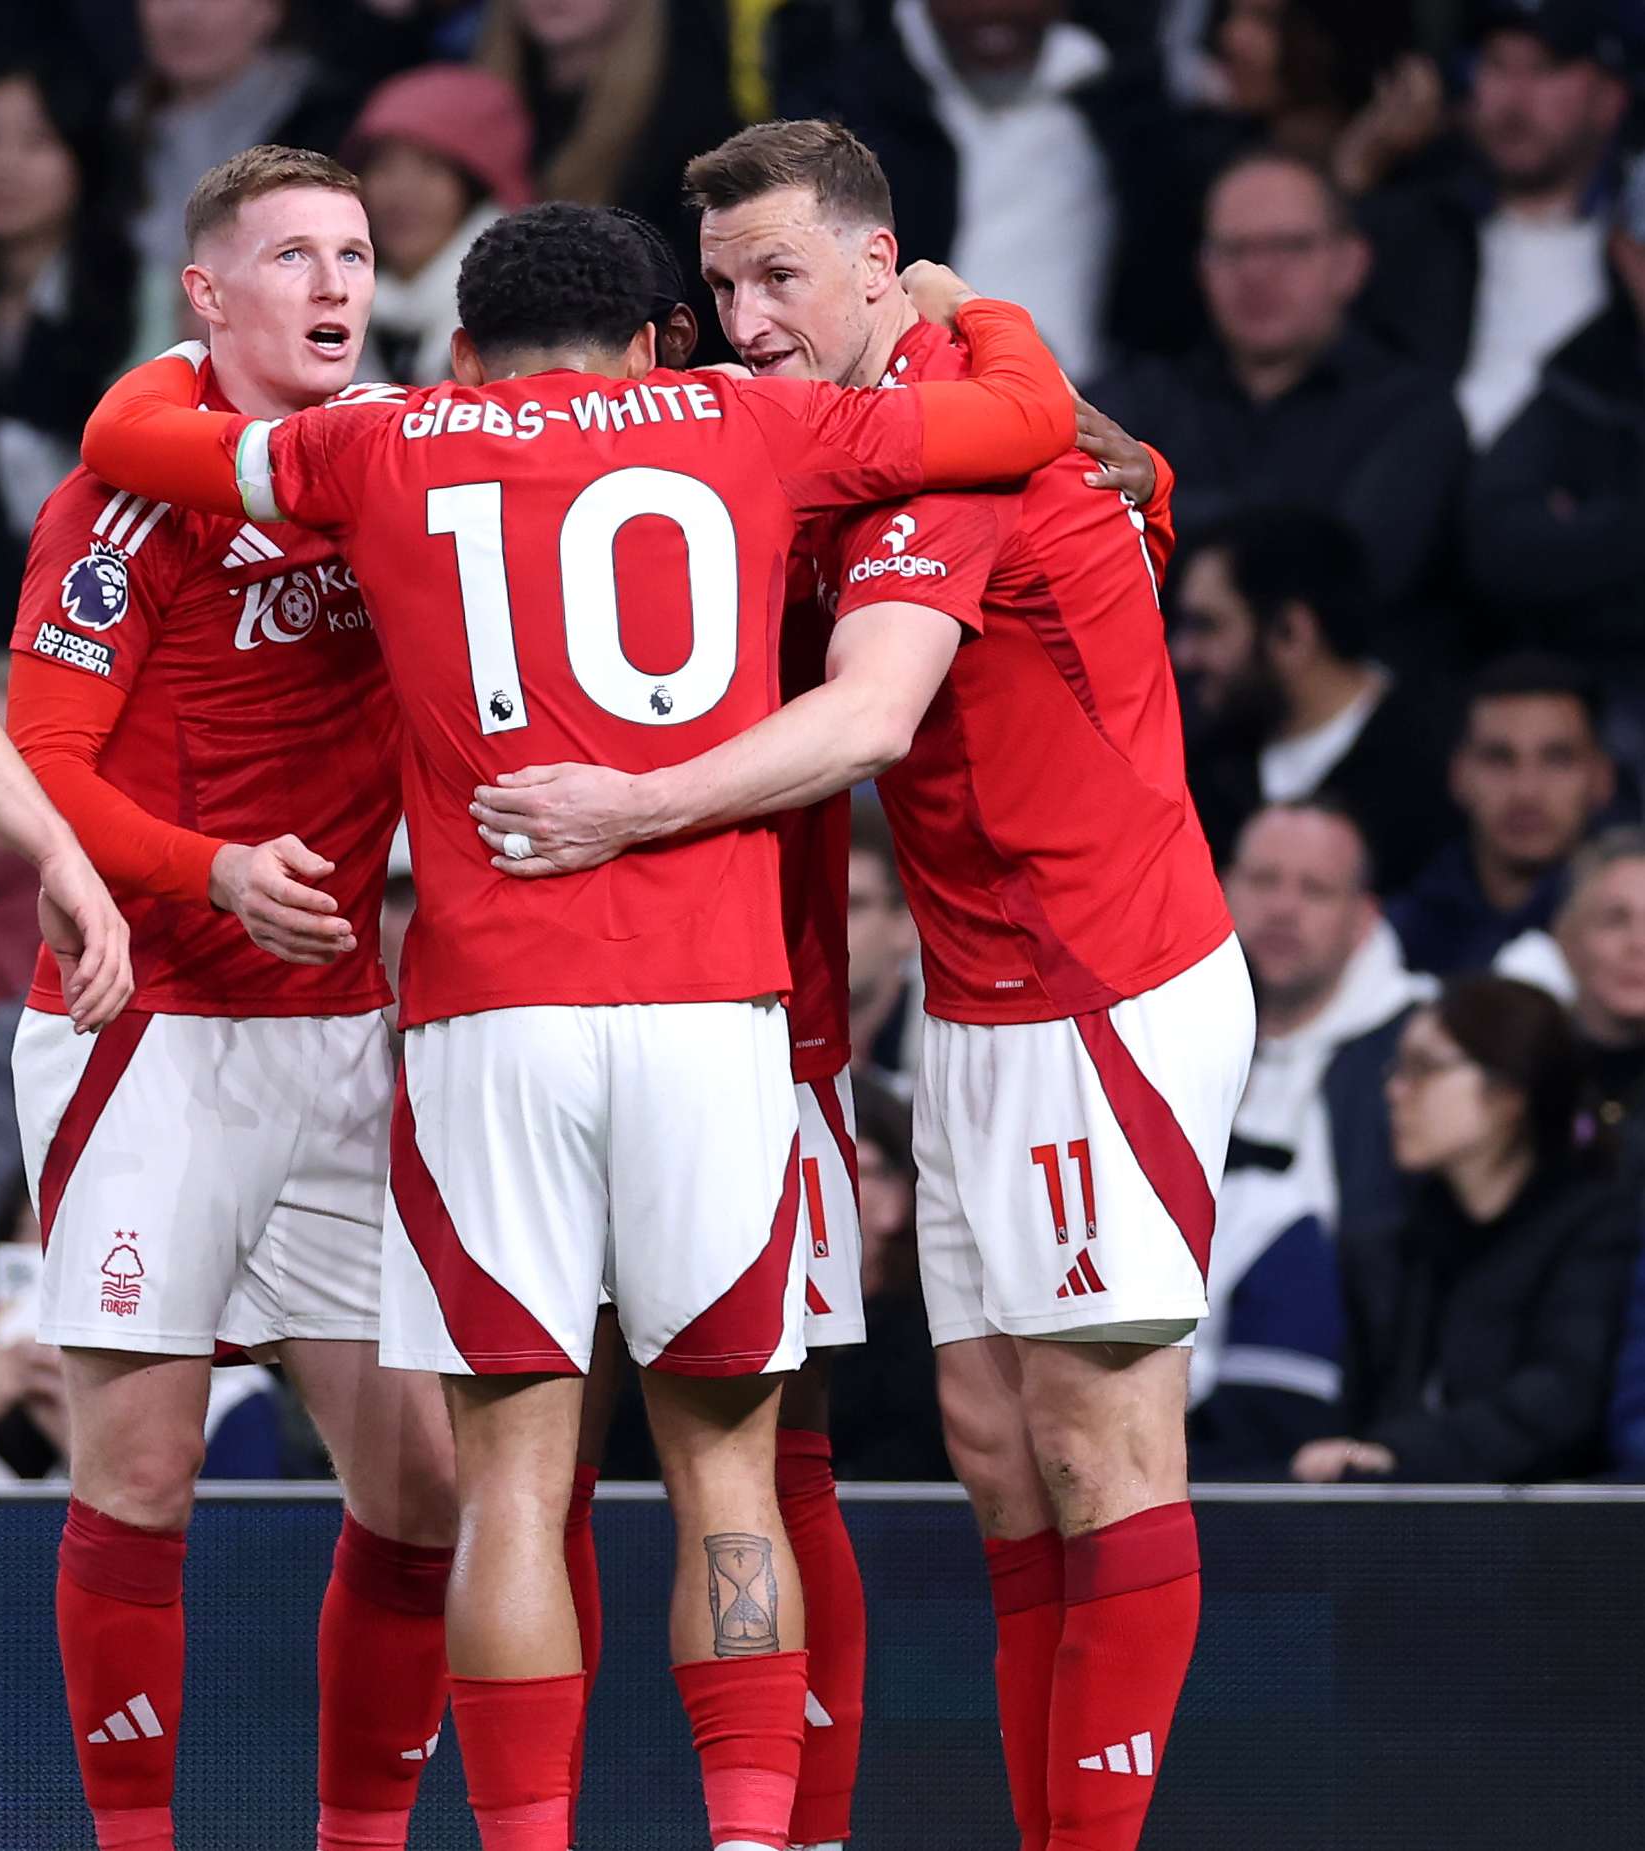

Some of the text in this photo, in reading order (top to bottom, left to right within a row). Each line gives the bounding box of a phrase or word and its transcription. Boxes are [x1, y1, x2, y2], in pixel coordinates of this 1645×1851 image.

[402, 383, 722, 440] GIBBS-WHITE
[426, 465, 739, 736] 10
[33, 638, 111, 677] for racism
[36, 622, 109, 662] No room
[1030, 1137, 1097, 1245] 11
